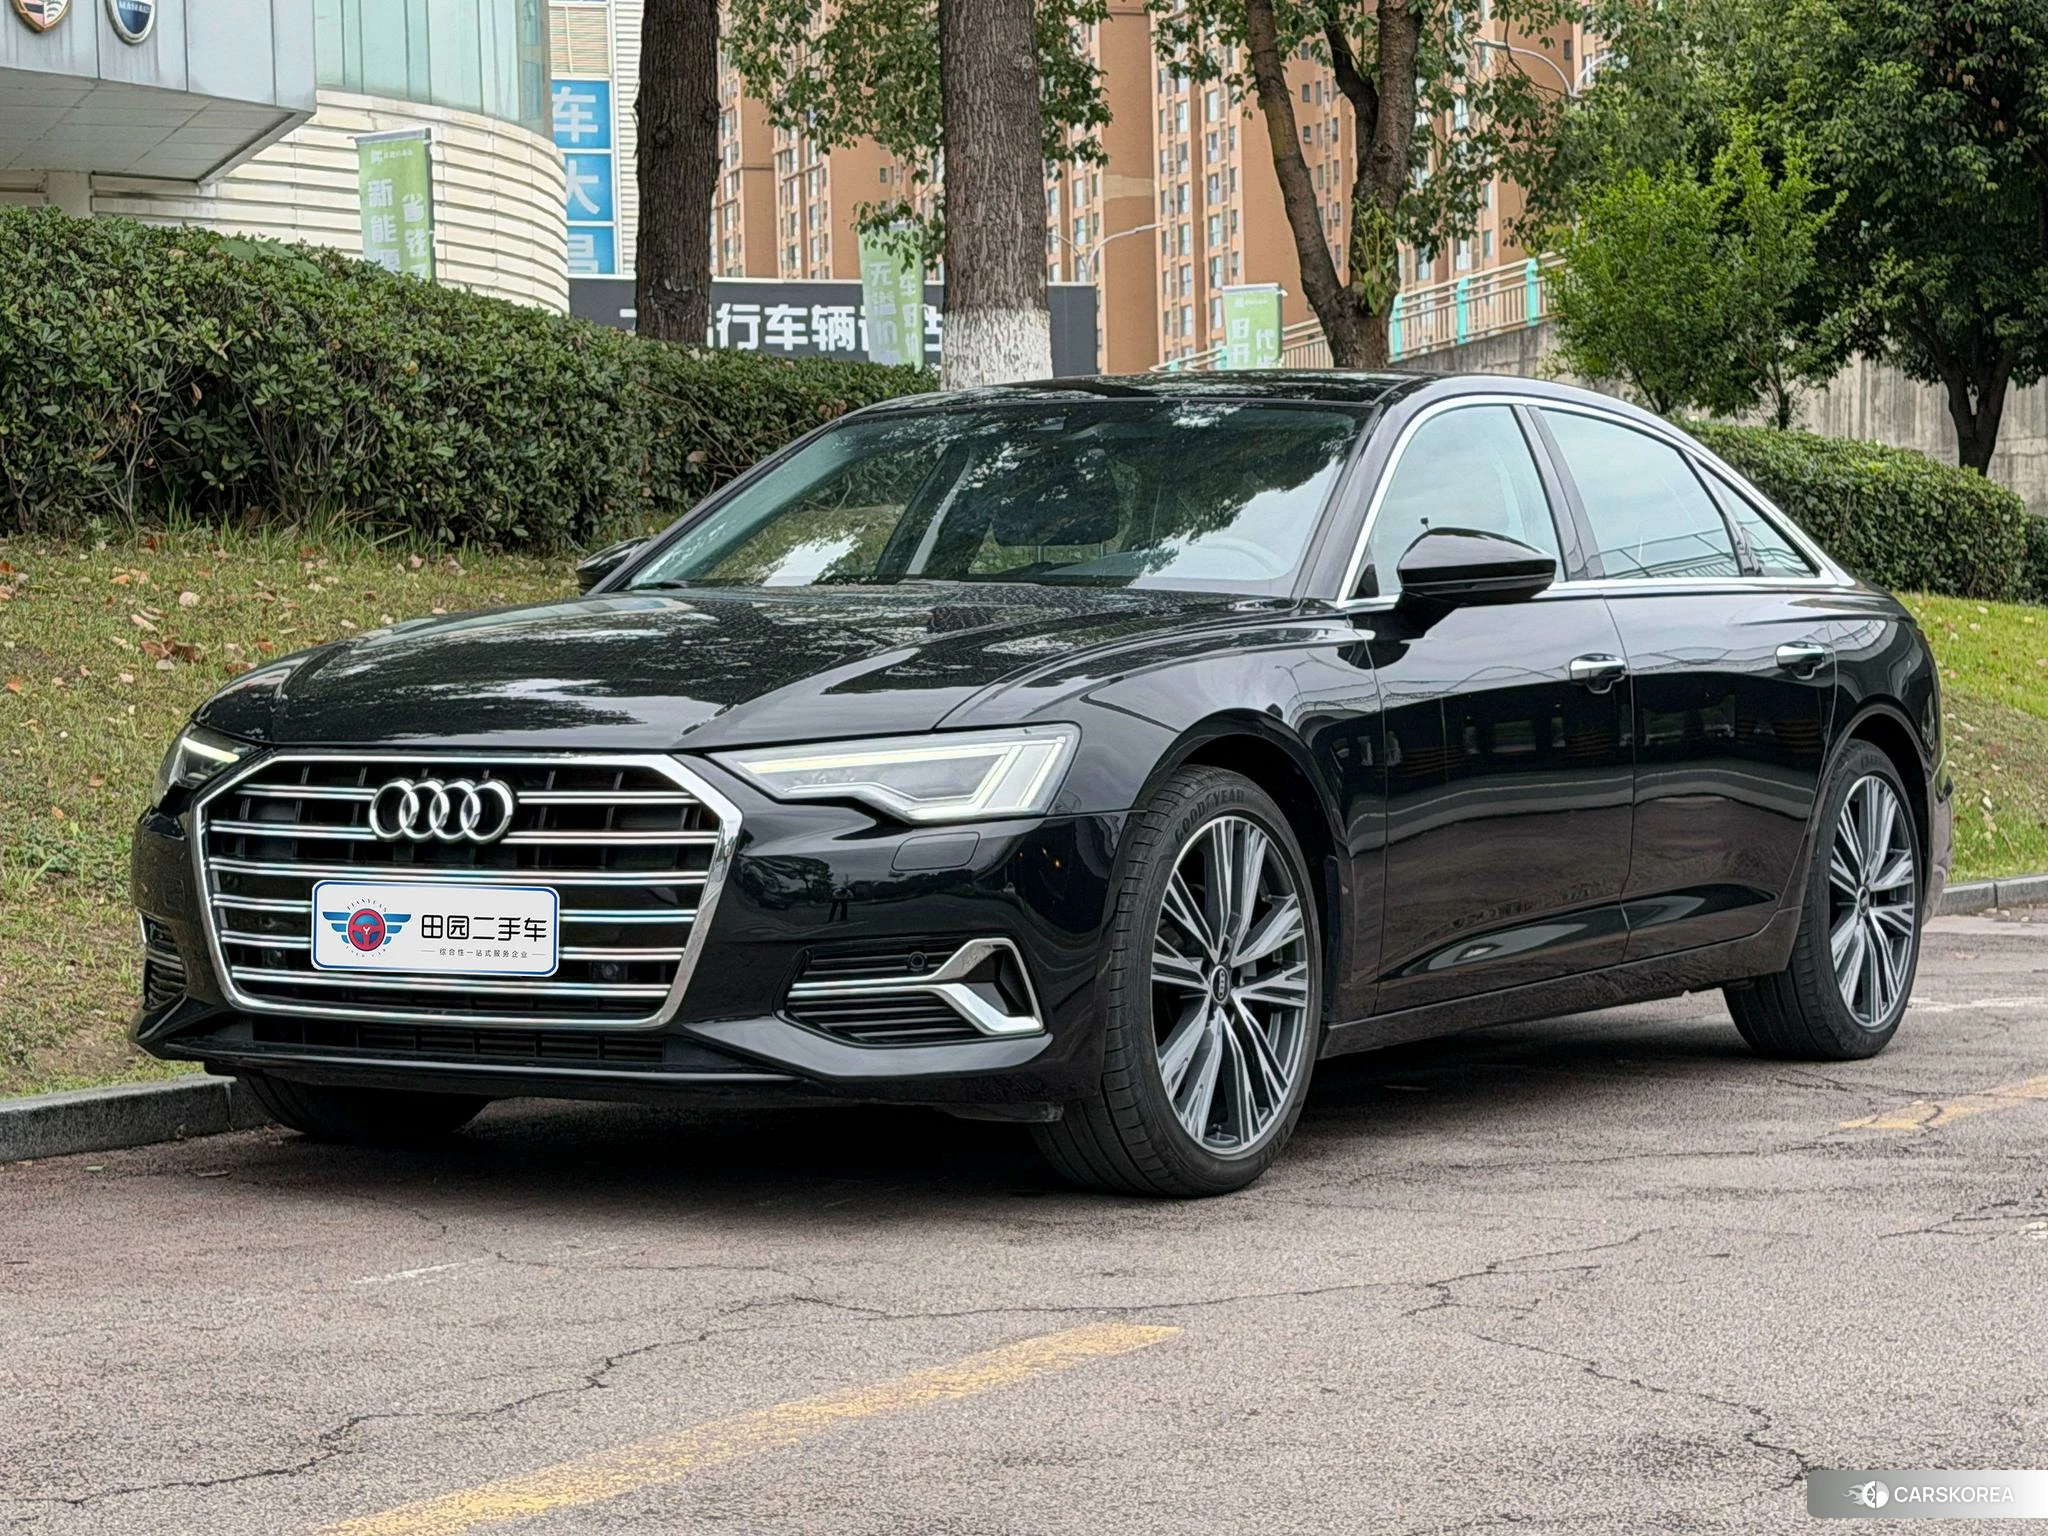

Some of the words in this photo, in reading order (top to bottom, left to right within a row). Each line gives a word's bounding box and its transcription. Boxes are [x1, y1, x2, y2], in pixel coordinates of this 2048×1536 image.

[1175, 788, 1245, 844] GOODYEAR
[421, 914, 547, 942] 田园二手车
[439, 948, 528, 959] 综合性一站式服务企业
